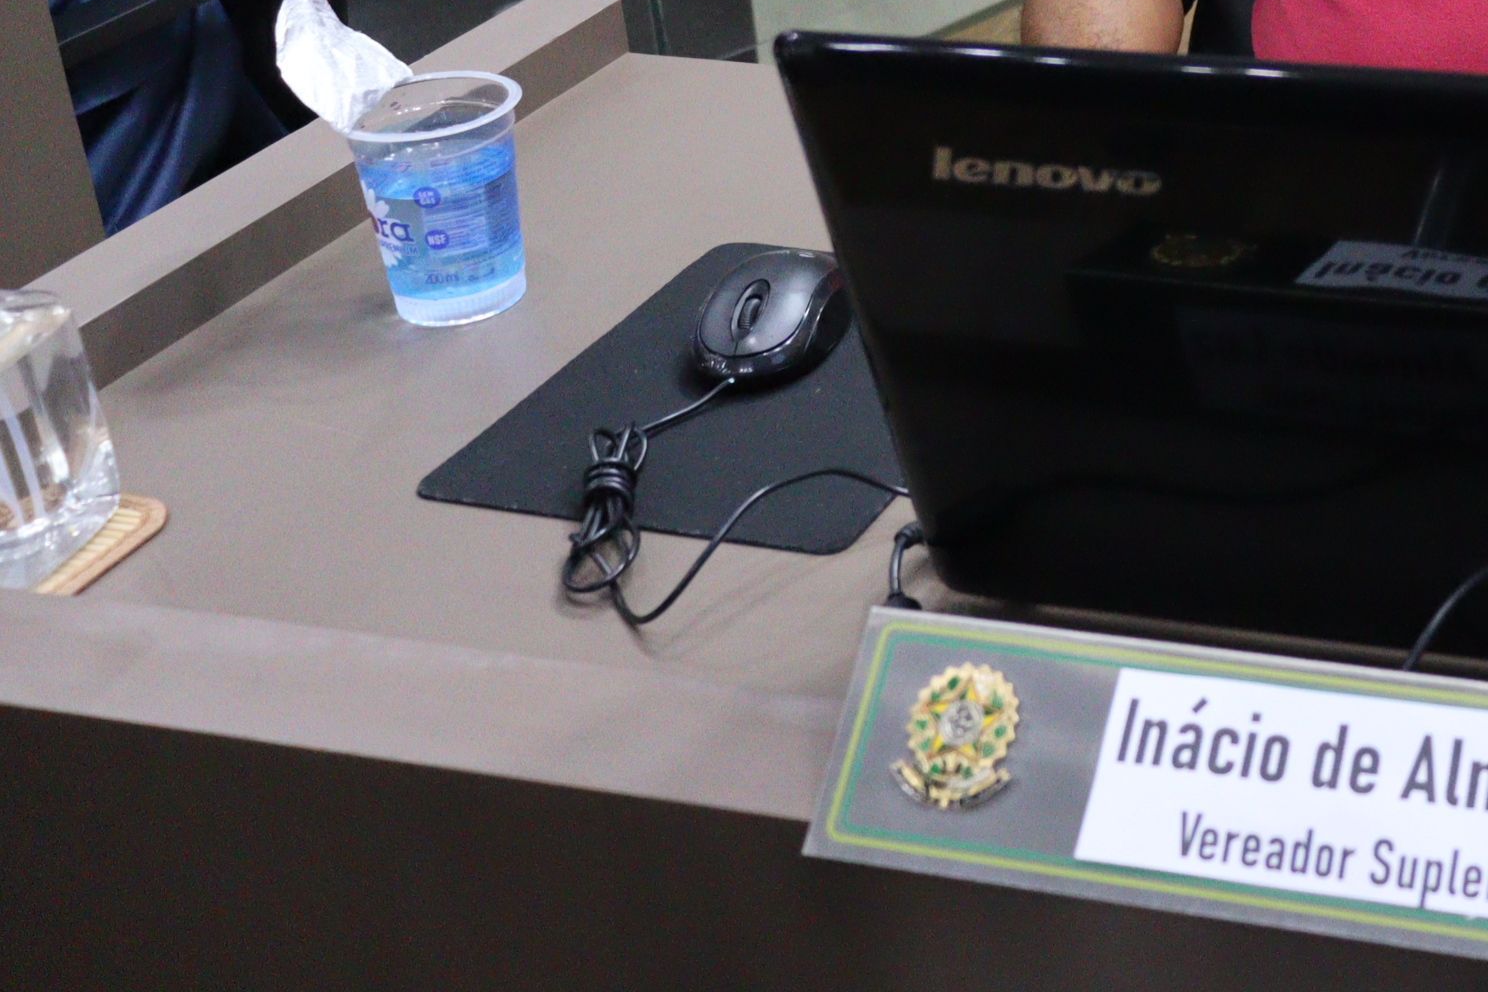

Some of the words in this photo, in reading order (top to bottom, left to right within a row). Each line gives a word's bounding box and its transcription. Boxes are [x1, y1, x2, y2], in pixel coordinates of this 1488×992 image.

[932, 146, 1162, 195] lenovo
[427, 233, 447, 246] NSF
[1117, 697, 1290, 782] Inácio
[1311, 724, 1381, 794] de
[1180, 811, 1355, 880] Vereador
